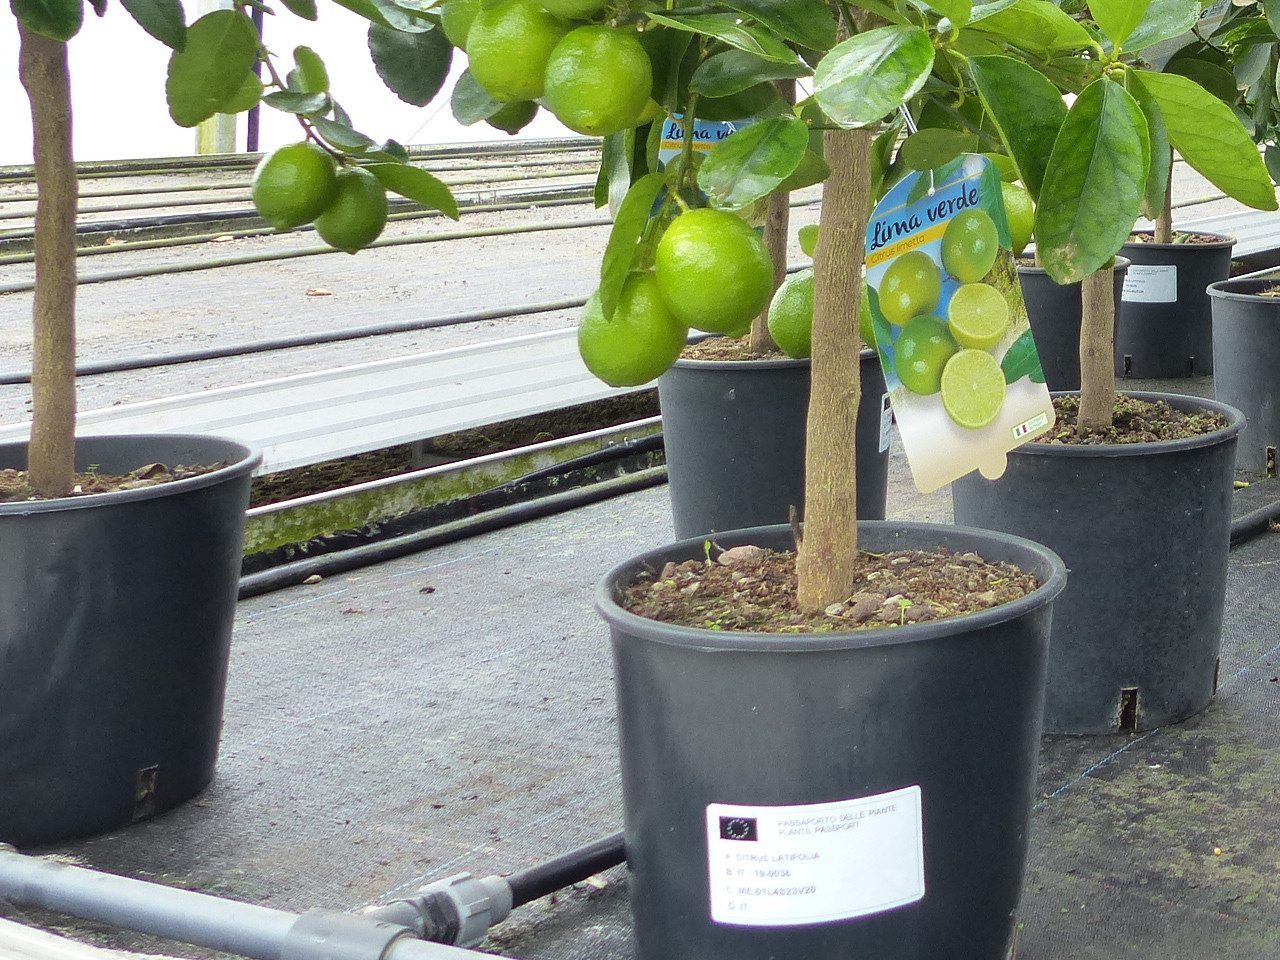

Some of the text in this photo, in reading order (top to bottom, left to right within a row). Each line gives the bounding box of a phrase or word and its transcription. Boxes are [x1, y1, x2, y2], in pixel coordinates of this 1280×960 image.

[870, 183, 979, 251] Lima verde
[870, 235, 926, 264] Citrus limetta
[839, 811, 866, 822] DELLE
[868, 803, 897, 816] PIANTE
